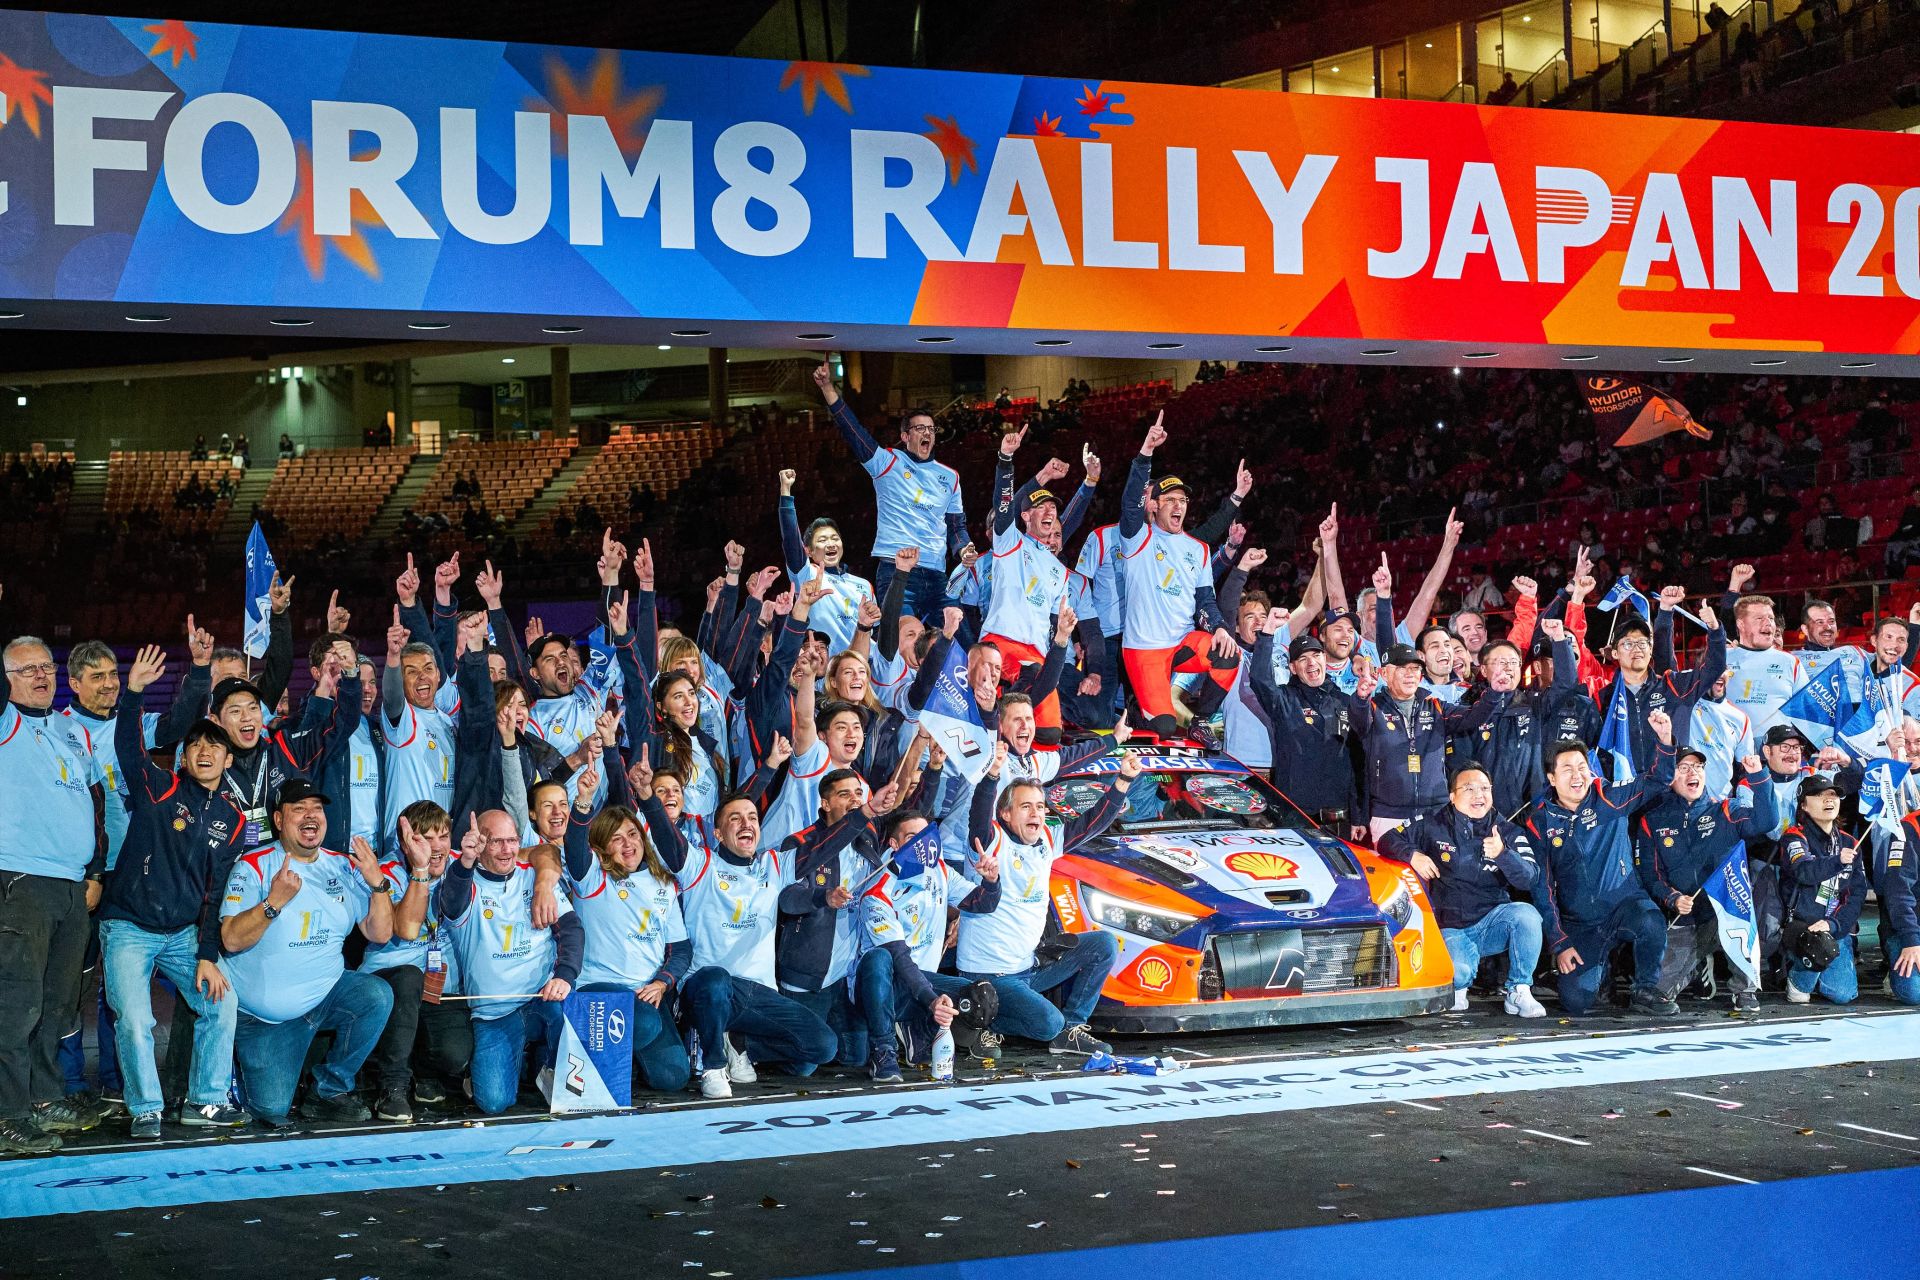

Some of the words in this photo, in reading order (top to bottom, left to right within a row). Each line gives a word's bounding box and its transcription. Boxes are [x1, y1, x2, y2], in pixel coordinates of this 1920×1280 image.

[53, 85, 811, 257] FORUM8
[851, 129, 1339, 275] RALLY
[1367, 156, 1798, 294] JAPAN
[1588, 386, 1642, 406] HYUNDAI
[1592, 395, 1642, 414] MOTORSPORT
[939, 671, 970, 711] HYUNDAI
[1807, 686, 1835, 721] MOTORSPO
[1812, 680, 1837, 711] HYUN
[1190, 836, 1305, 848] MOBIS
[1726, 861, 1752, 909] HYUNDA
[1056, 893, 1076, 926] WIA
[289, 939, 328, 948] CHAMPIONS
[596, 1001, 605, 1052] HYUNDAI
[706, 1104, 950, 1135] 2024
[957, 1090, 1121, 1111] FIA
[1105, 1072, 1337, 1096] WRC
[1339, 1033, 1831, 1078] CHAMPIONS
[1104, 1091, 1282, 1112] DRIVERS'
[166, 1153, 445, 1179] HYUNDAI
